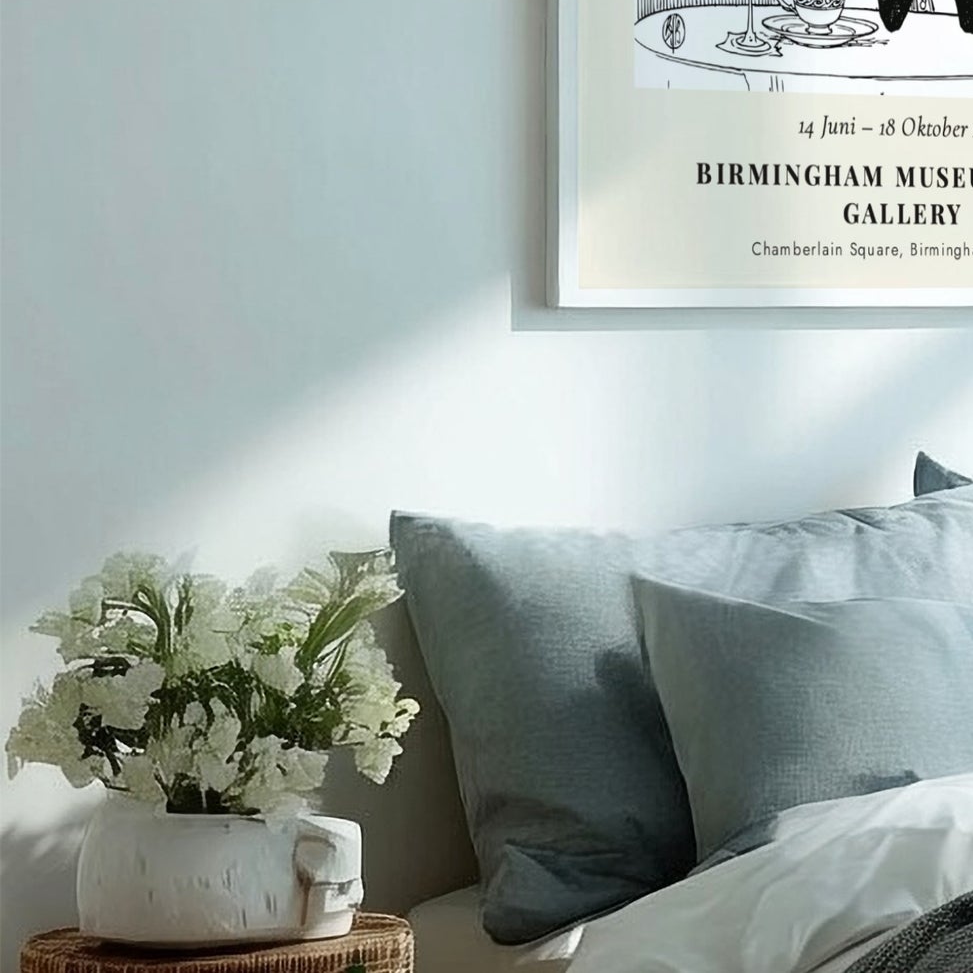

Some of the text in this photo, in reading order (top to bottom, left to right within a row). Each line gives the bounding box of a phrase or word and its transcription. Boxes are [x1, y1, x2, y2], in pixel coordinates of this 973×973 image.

[799, 121, 814, 139] 14
[820, 115, 857, 140] Juni
[880, 118, 896, 136] 18
[901, 115, 969, 138] Oktober
[696, 162, 882, 188] BIRMINGHAM
[843, 202, 961, 226] GALLERY
[751, 241, 842, 256] Chamberlain
[850, 242, 903, 260] Square,
